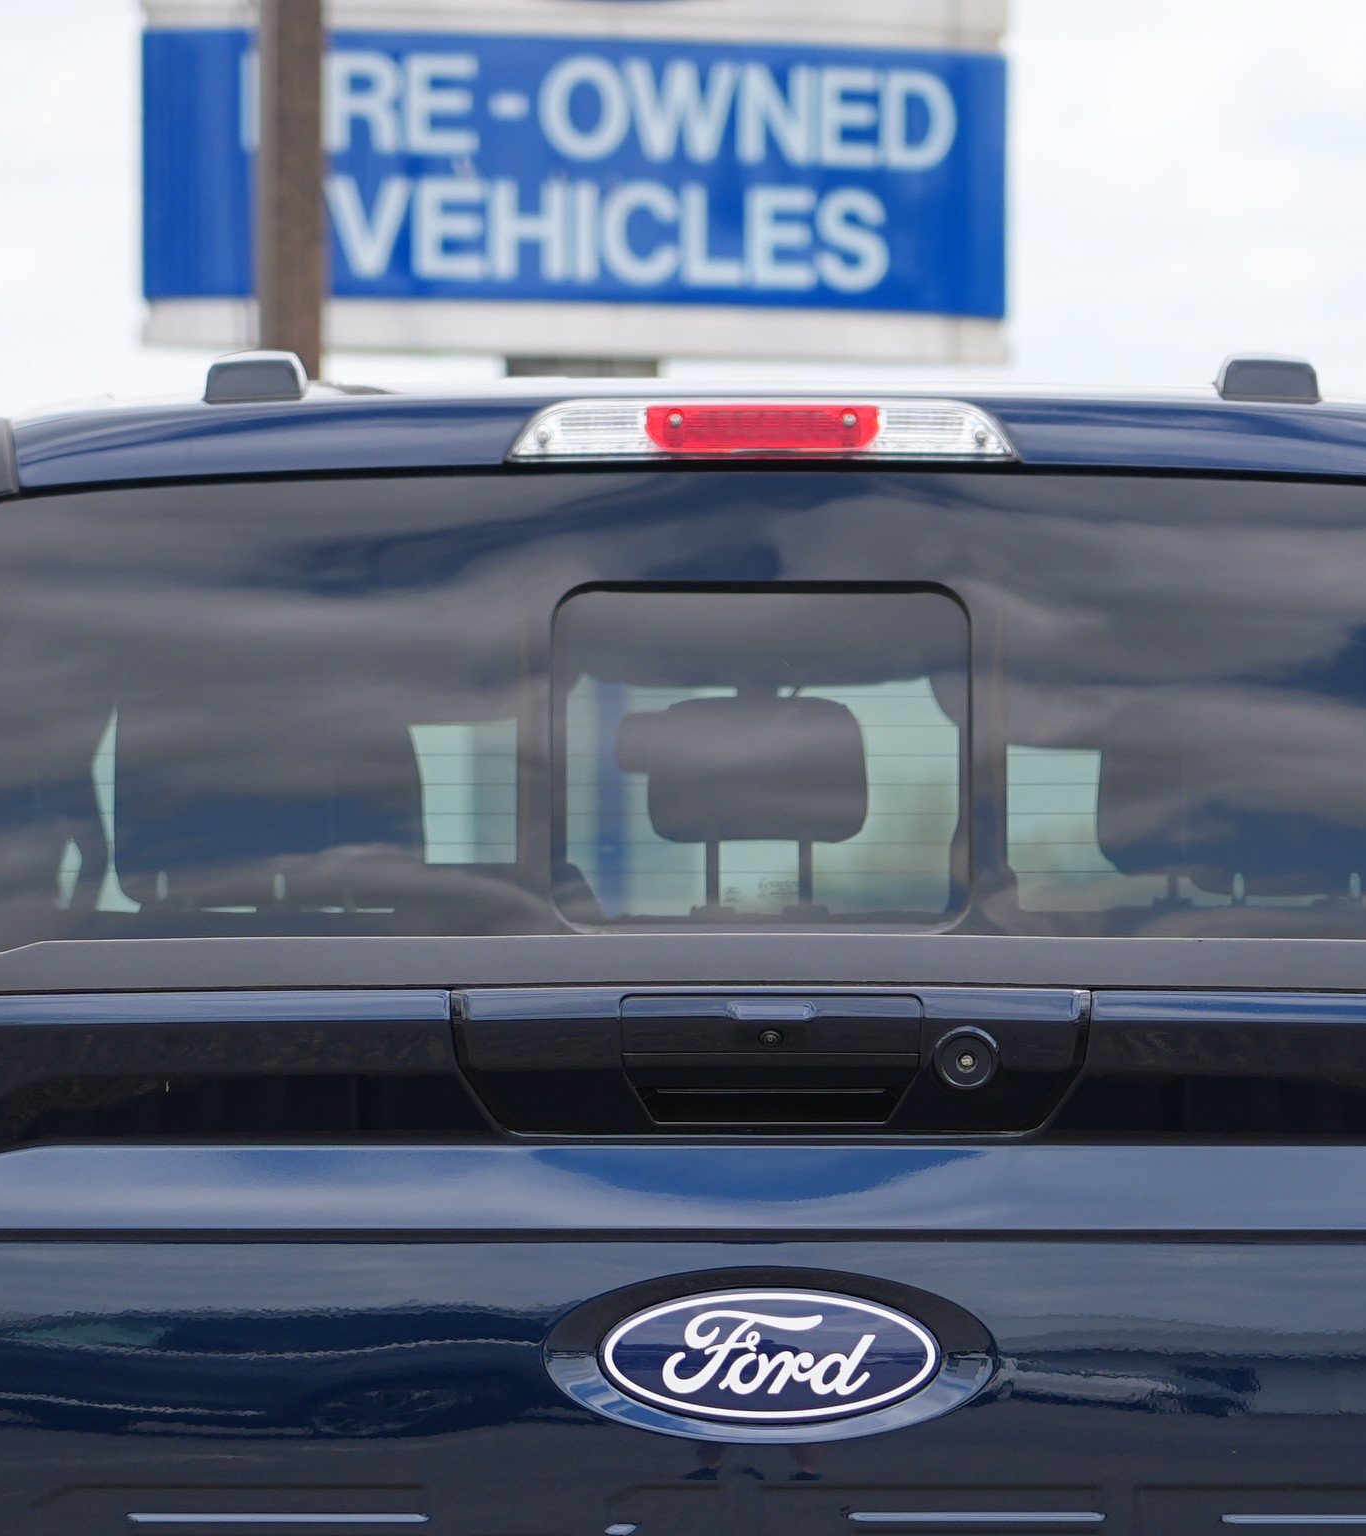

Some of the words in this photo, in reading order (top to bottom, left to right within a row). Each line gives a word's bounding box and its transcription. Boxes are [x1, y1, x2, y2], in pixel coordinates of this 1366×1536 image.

[241, 50, 958, 171] RE-OWNED
[328, 175, 891, 292] VEHICLES
[661, 1309, 878, 1396] Ford
